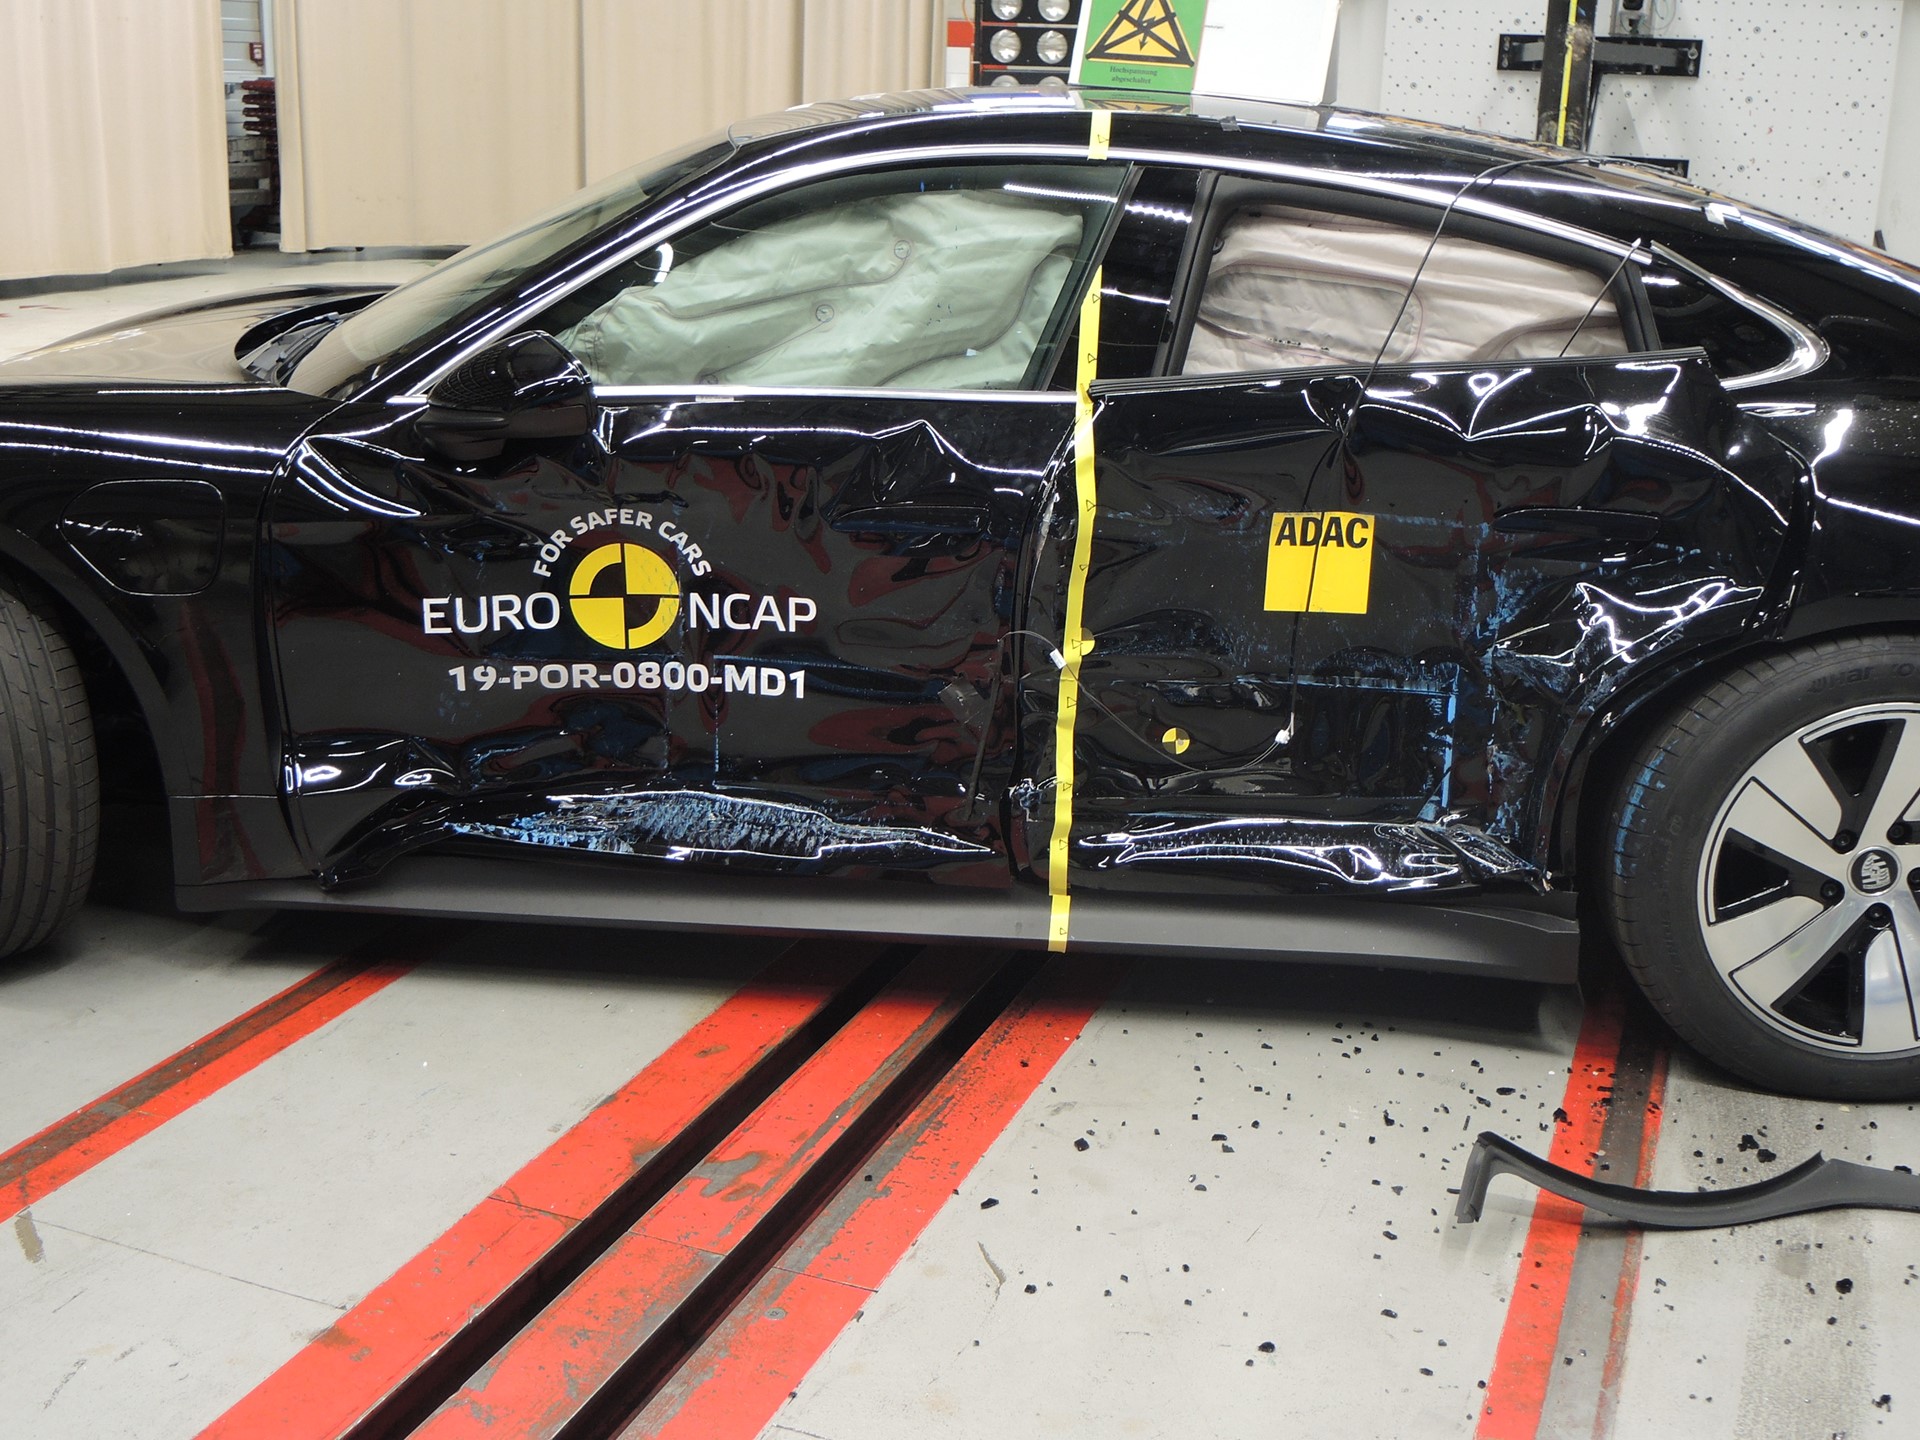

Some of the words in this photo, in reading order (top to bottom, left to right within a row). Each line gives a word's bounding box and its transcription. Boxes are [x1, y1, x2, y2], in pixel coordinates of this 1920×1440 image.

[1109, 65, 1158, 77] Hochspannung
[1111, 75, 1152, 85] abgeschaltet
[533, 530, 573, 577] FOR
[570, 509, 652, 535] SAFER
[658, 521, 712, 577] CARS
[1275, 516, 1369, 549] ADAC
[423, 592, 561, 634] EURO
[689, 593, 817, 633] NCAP
[449, 661, 806, 699] 19-POR-0800-MD1
